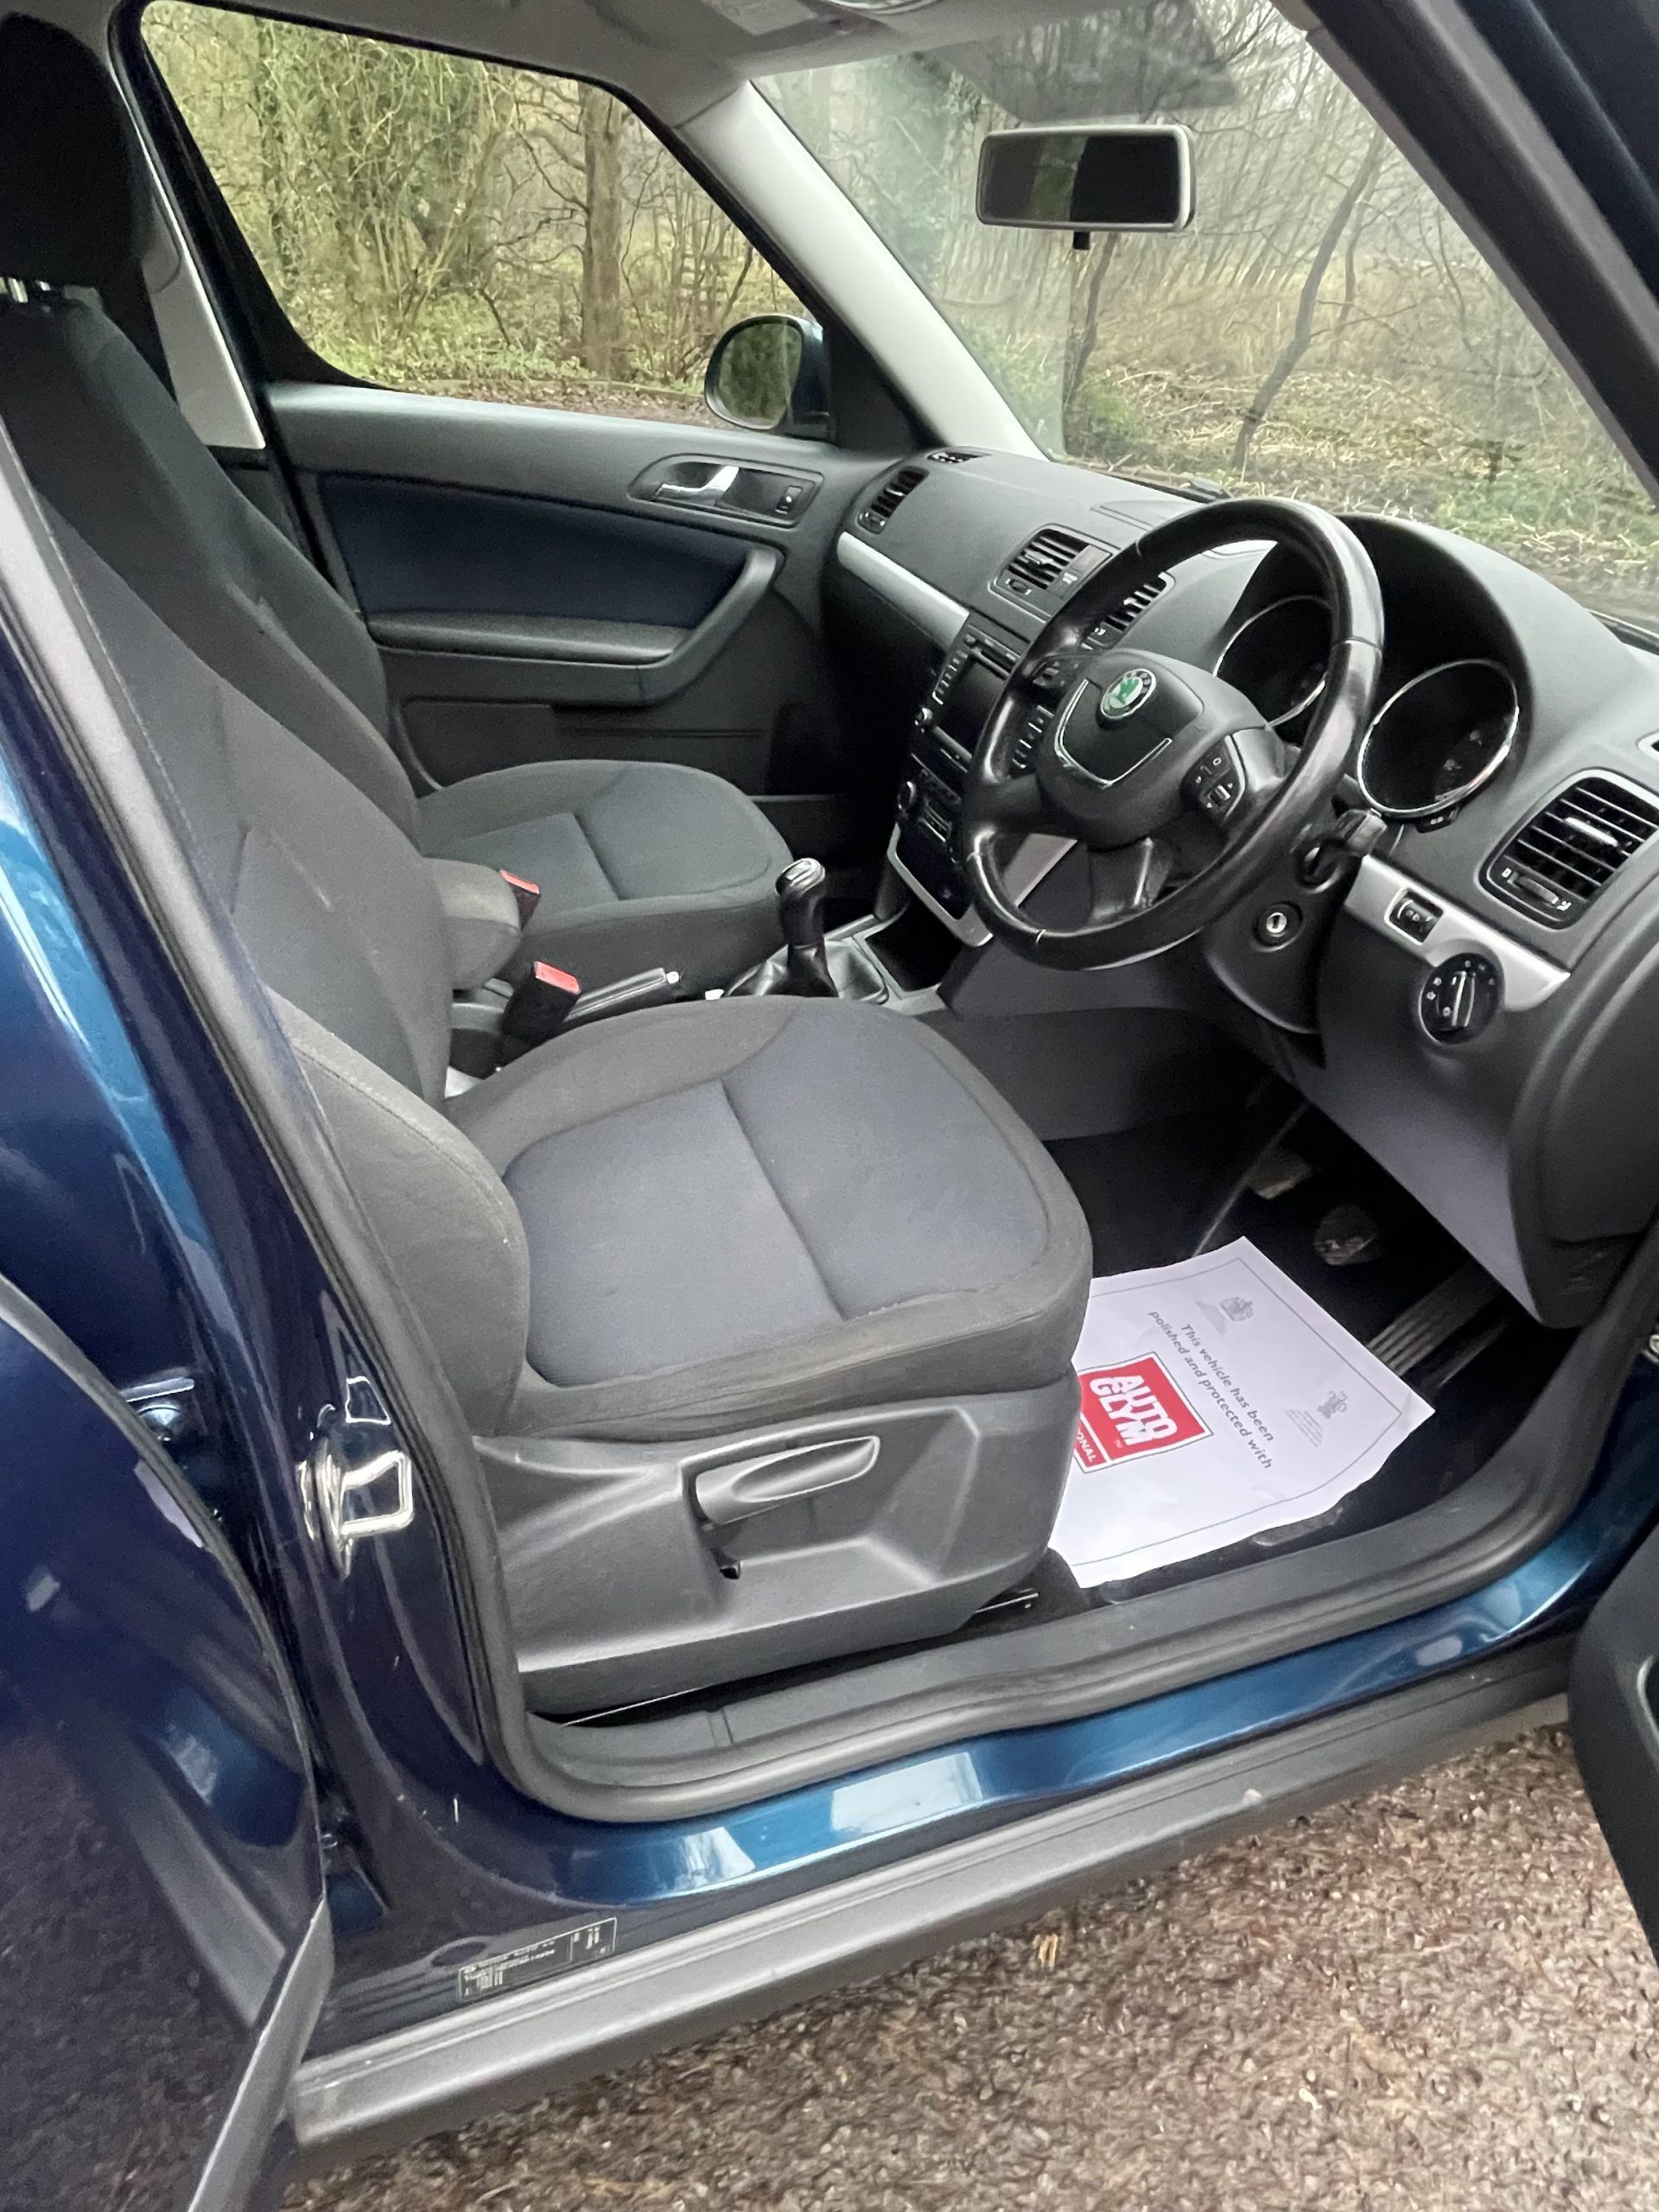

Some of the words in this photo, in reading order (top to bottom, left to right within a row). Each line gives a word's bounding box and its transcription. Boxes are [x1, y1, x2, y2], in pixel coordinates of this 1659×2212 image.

[1111, 1375, 1178, 1440] AUTO
[1147, 1311, 1191, 1354] polished
[1184, 1357, 1207, 1377] and
[1198, 1379, 1253, 1437] protected
[1247, 1439, 1273, 1469] with
[1181, 1323, 1201, 1347] This
[1199, 1348, 1232, 1387] vehicle
[1230, 1387, 1250, 1408] has
[1247, 1409, 1274, 1441] been
